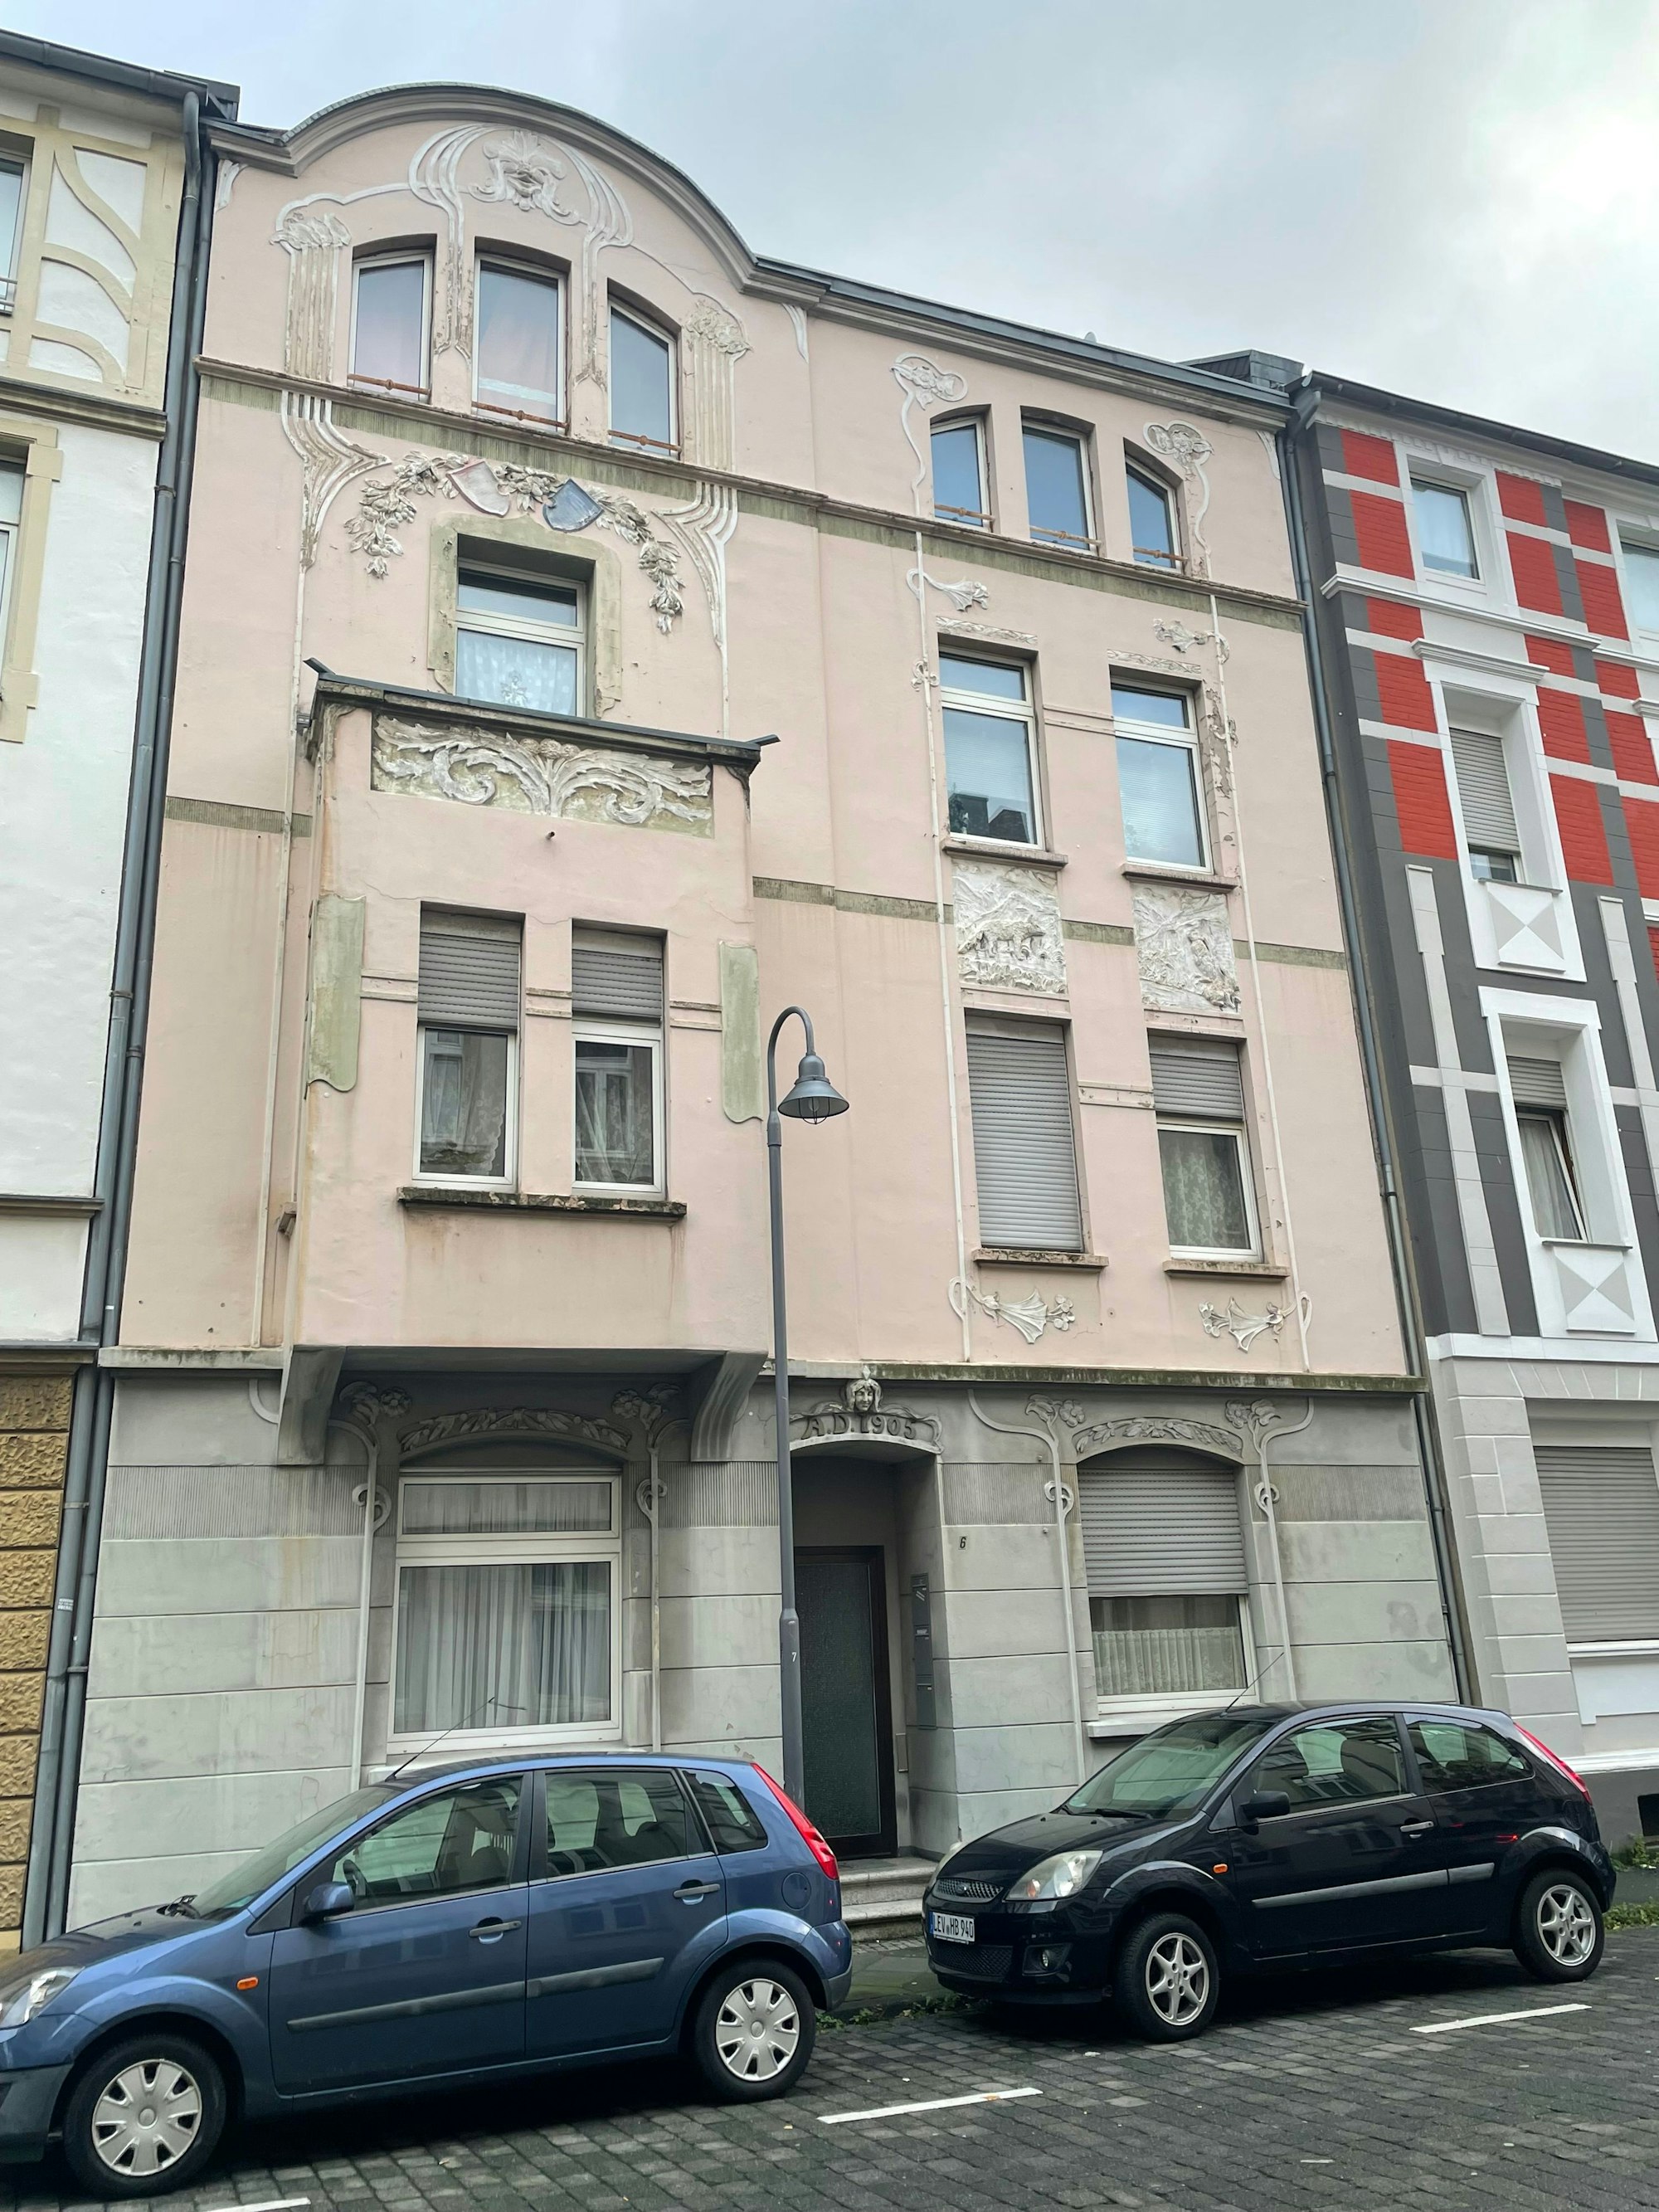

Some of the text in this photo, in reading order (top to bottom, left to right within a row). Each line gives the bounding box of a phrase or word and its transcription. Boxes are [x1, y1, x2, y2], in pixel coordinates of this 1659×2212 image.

[800, 1414, 917, 1440] A.D. 1905
[960, 1537, 966, 1549] 6
[791, 1651, 797, 1663] 7
[934, 1915, 974, 1938] LEV HB 940
